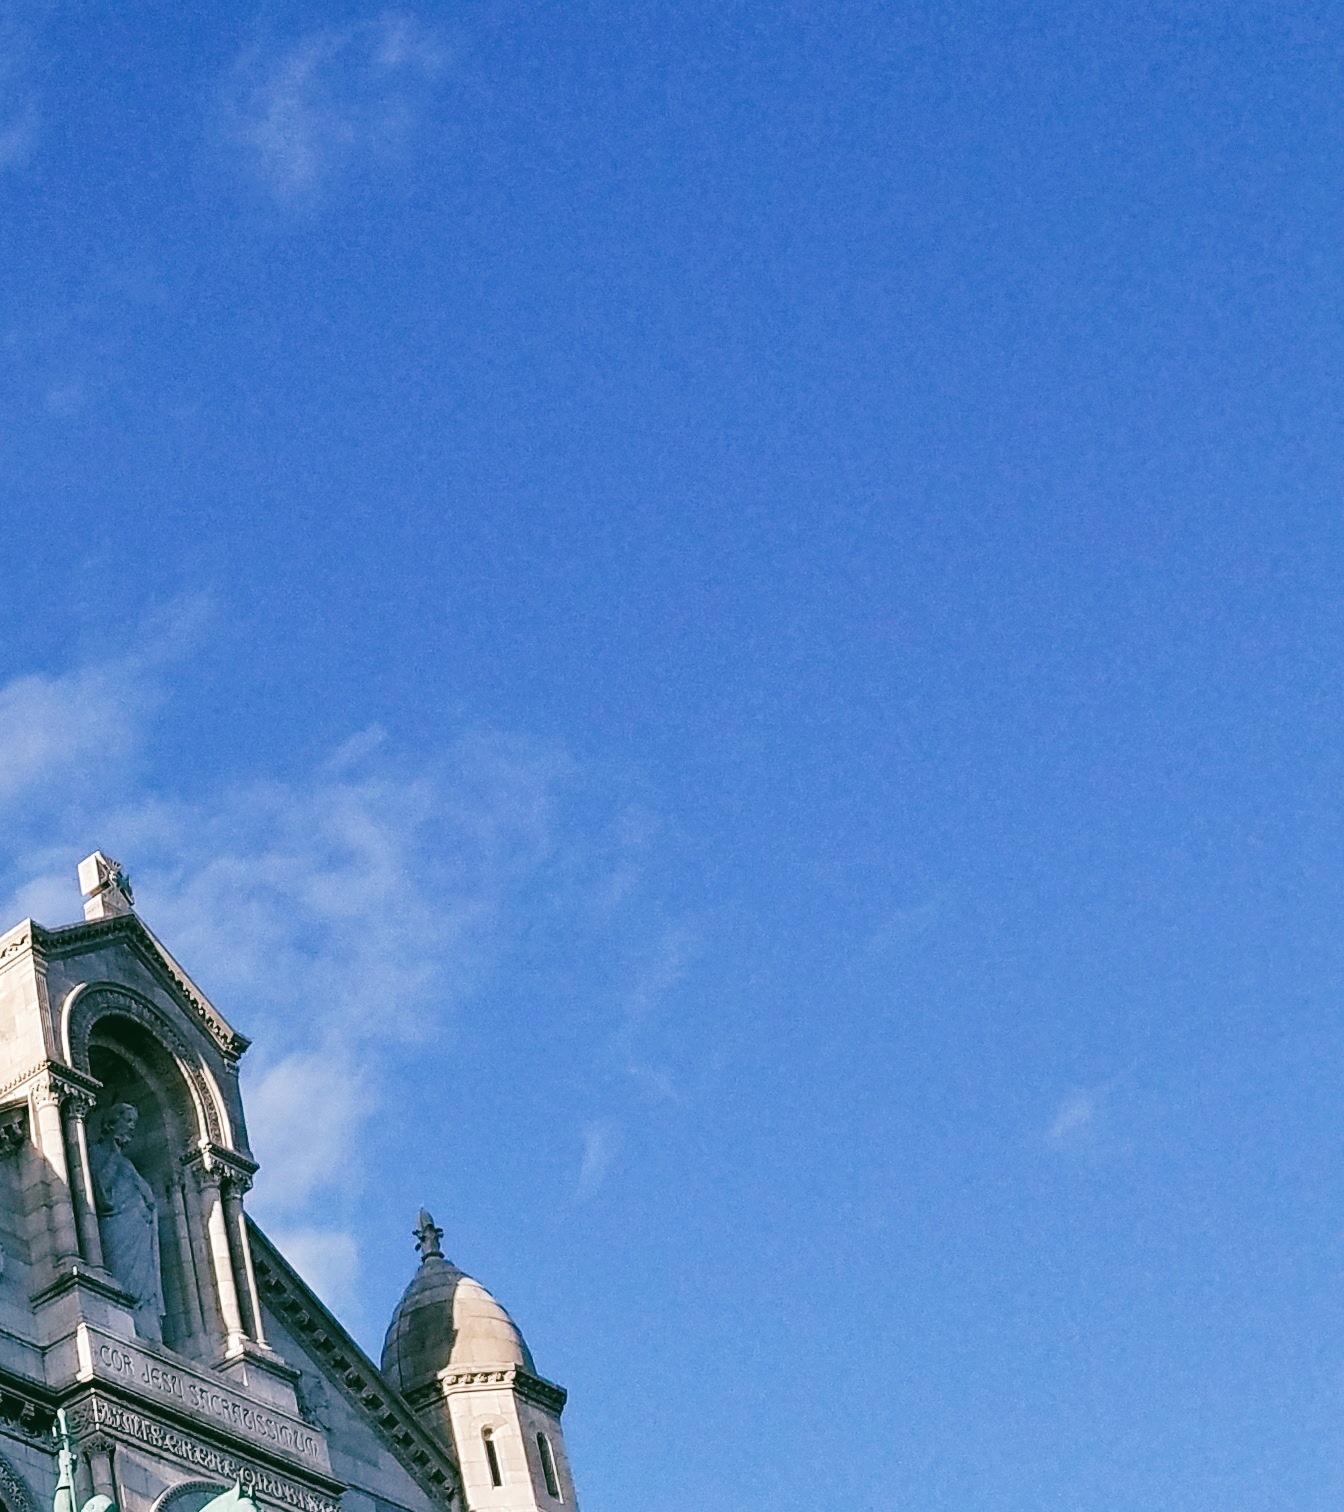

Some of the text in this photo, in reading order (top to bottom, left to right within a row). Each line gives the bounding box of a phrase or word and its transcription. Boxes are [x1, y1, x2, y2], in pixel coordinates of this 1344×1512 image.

[100, 1345, 320, 1458] COR JESU SACRATISSIMUM
